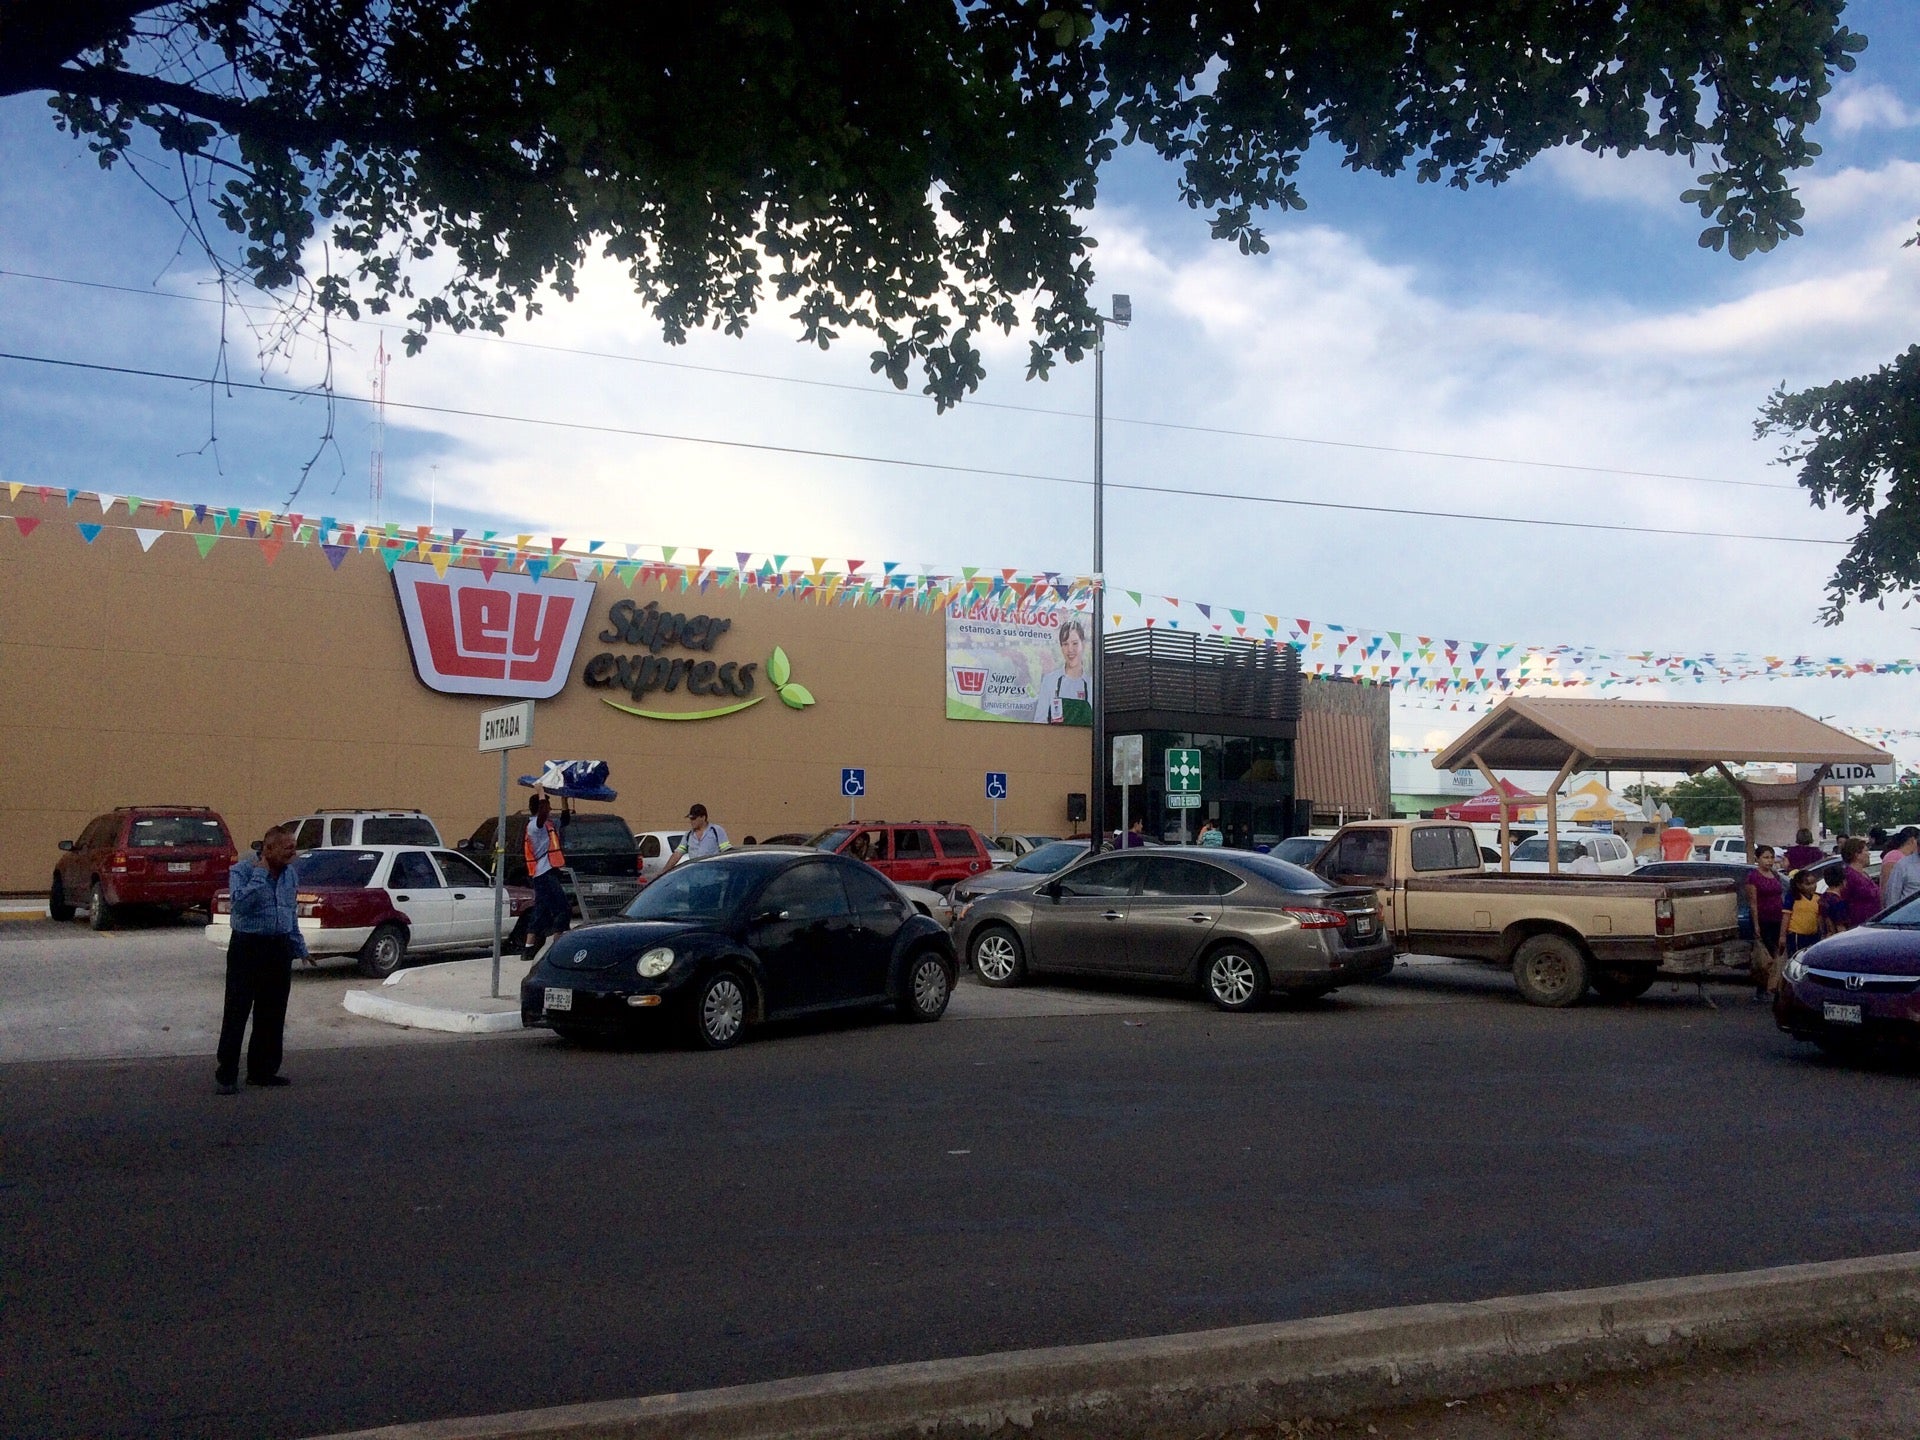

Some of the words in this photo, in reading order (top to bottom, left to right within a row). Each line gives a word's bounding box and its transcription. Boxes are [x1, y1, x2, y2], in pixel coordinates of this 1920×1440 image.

[599, 599, 731, 653] Súper
[959, 624, 994, 635] estamos
[1003, 629, 1017, 637] sus
[583, 653, 758, 702] express
[987, 685, 1026, 696] express
[984, 702, 1033, 711] UNIVERSITARIOS
[485, 715, 520, 741] ENTRADA
